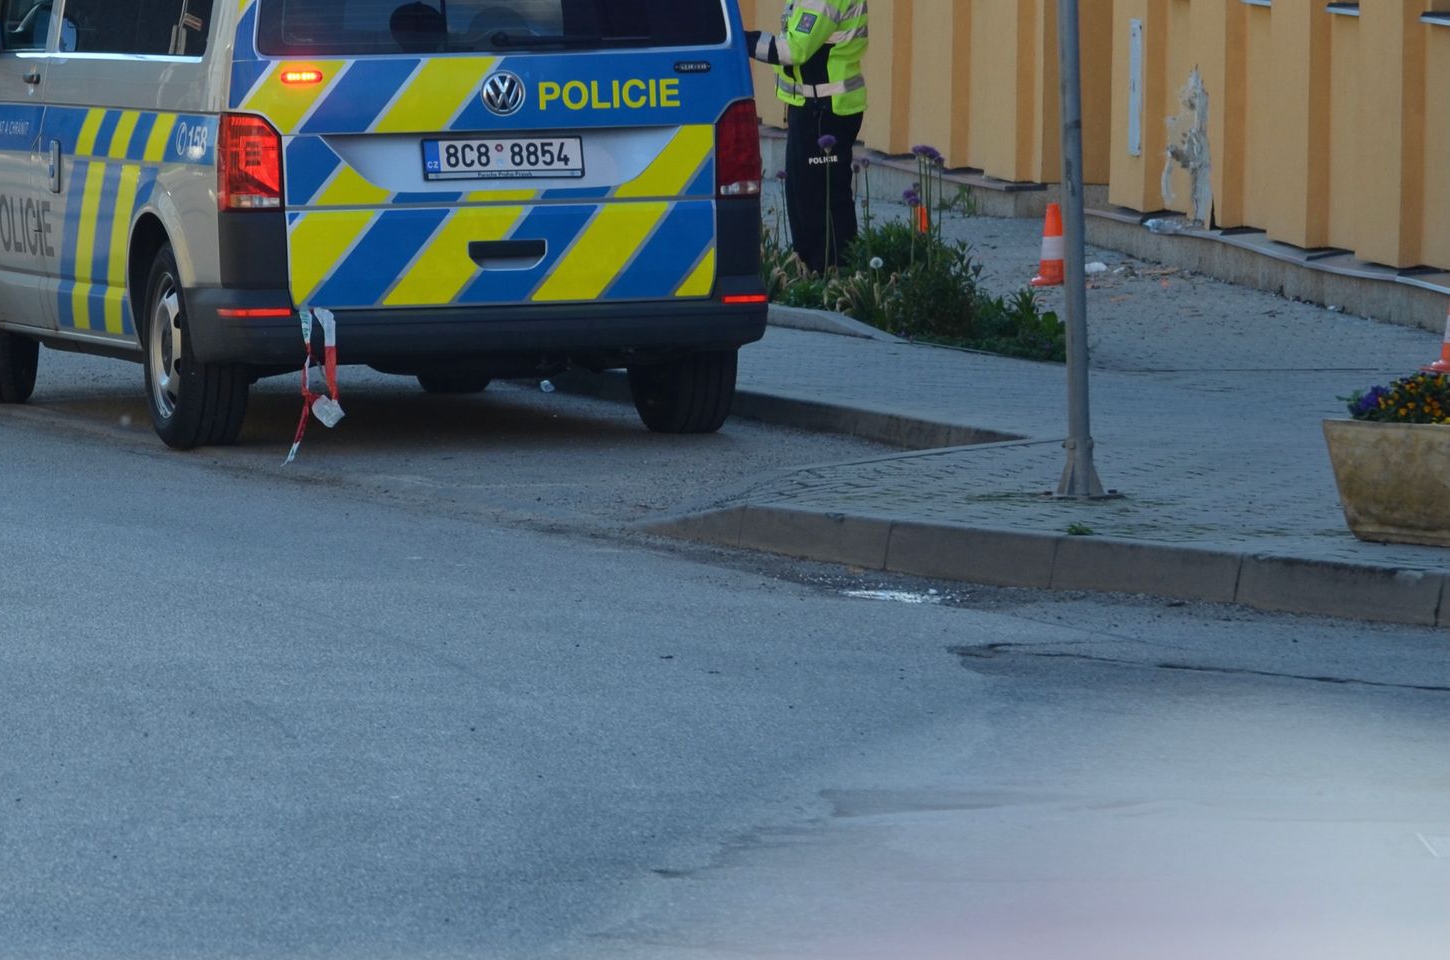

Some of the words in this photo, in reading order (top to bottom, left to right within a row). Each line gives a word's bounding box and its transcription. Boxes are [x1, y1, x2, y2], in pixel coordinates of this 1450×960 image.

[538, 78, 681, 111] POLICIE
[187, 125, 208, 156] 158
[427, 161, 439, 169] CZ
[445, 143, 491, 168] 8C8
[509, 142, 570, 167] 8854
[808, 155, 838, 165] POLICIE
